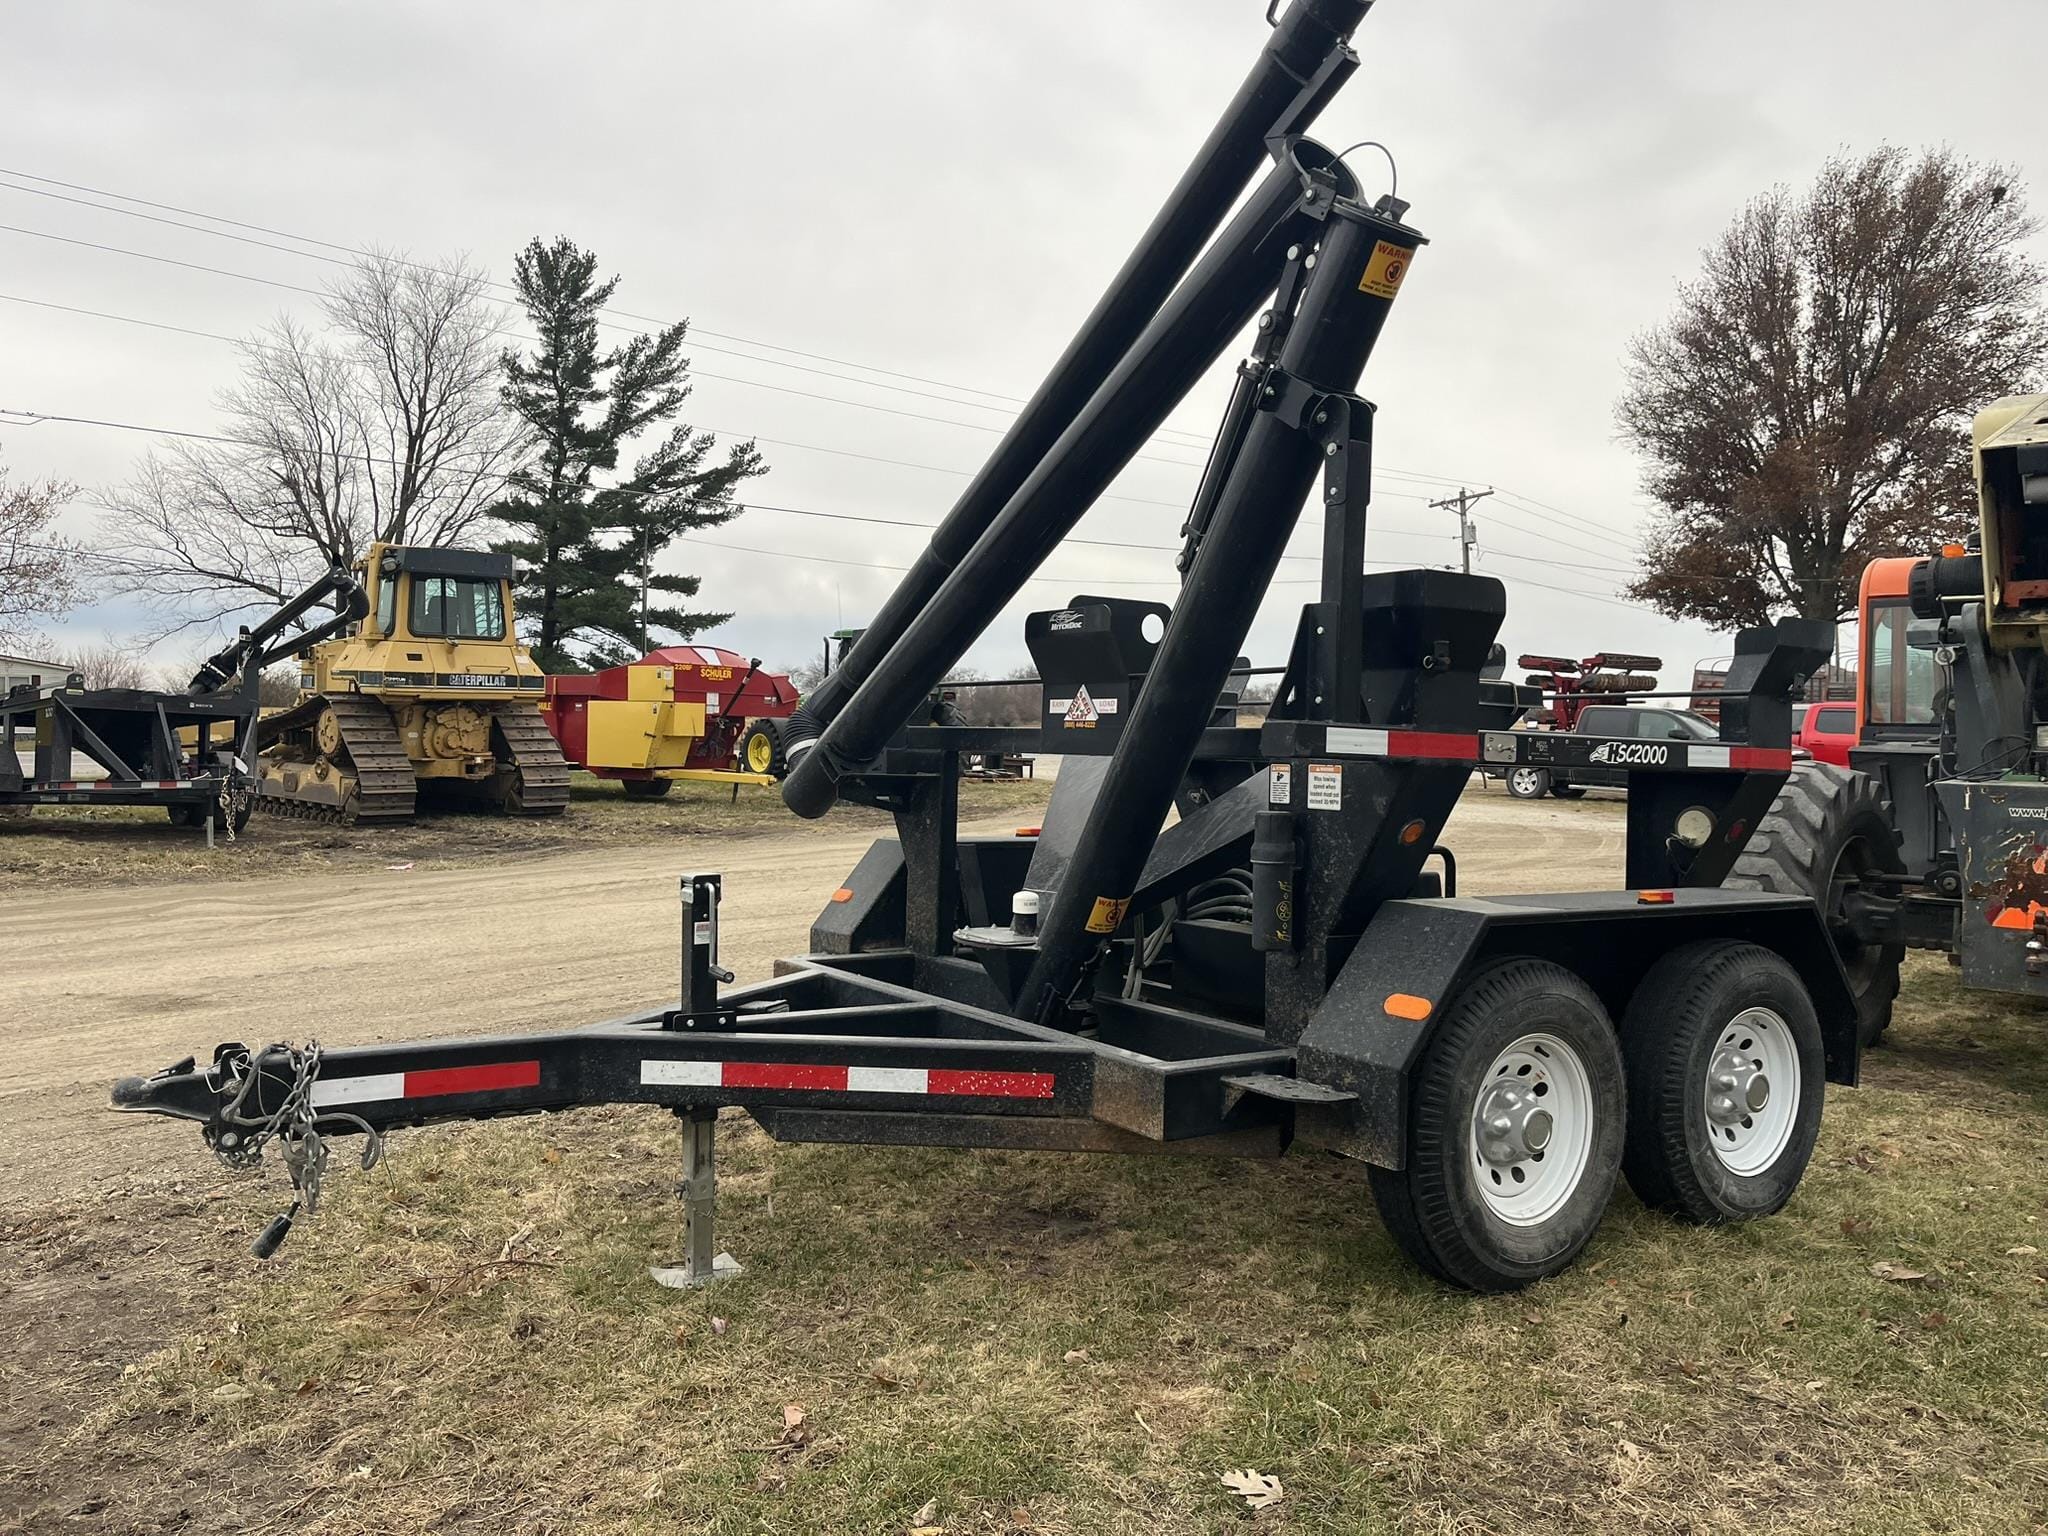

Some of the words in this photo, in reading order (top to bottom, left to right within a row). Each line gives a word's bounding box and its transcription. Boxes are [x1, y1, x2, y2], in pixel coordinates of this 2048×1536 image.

[700, 668, 733, 679] SCHULER
[449, 675, 506, 687] CATERPILLAR
[1608, 742, 1668, 765] HSC2000
